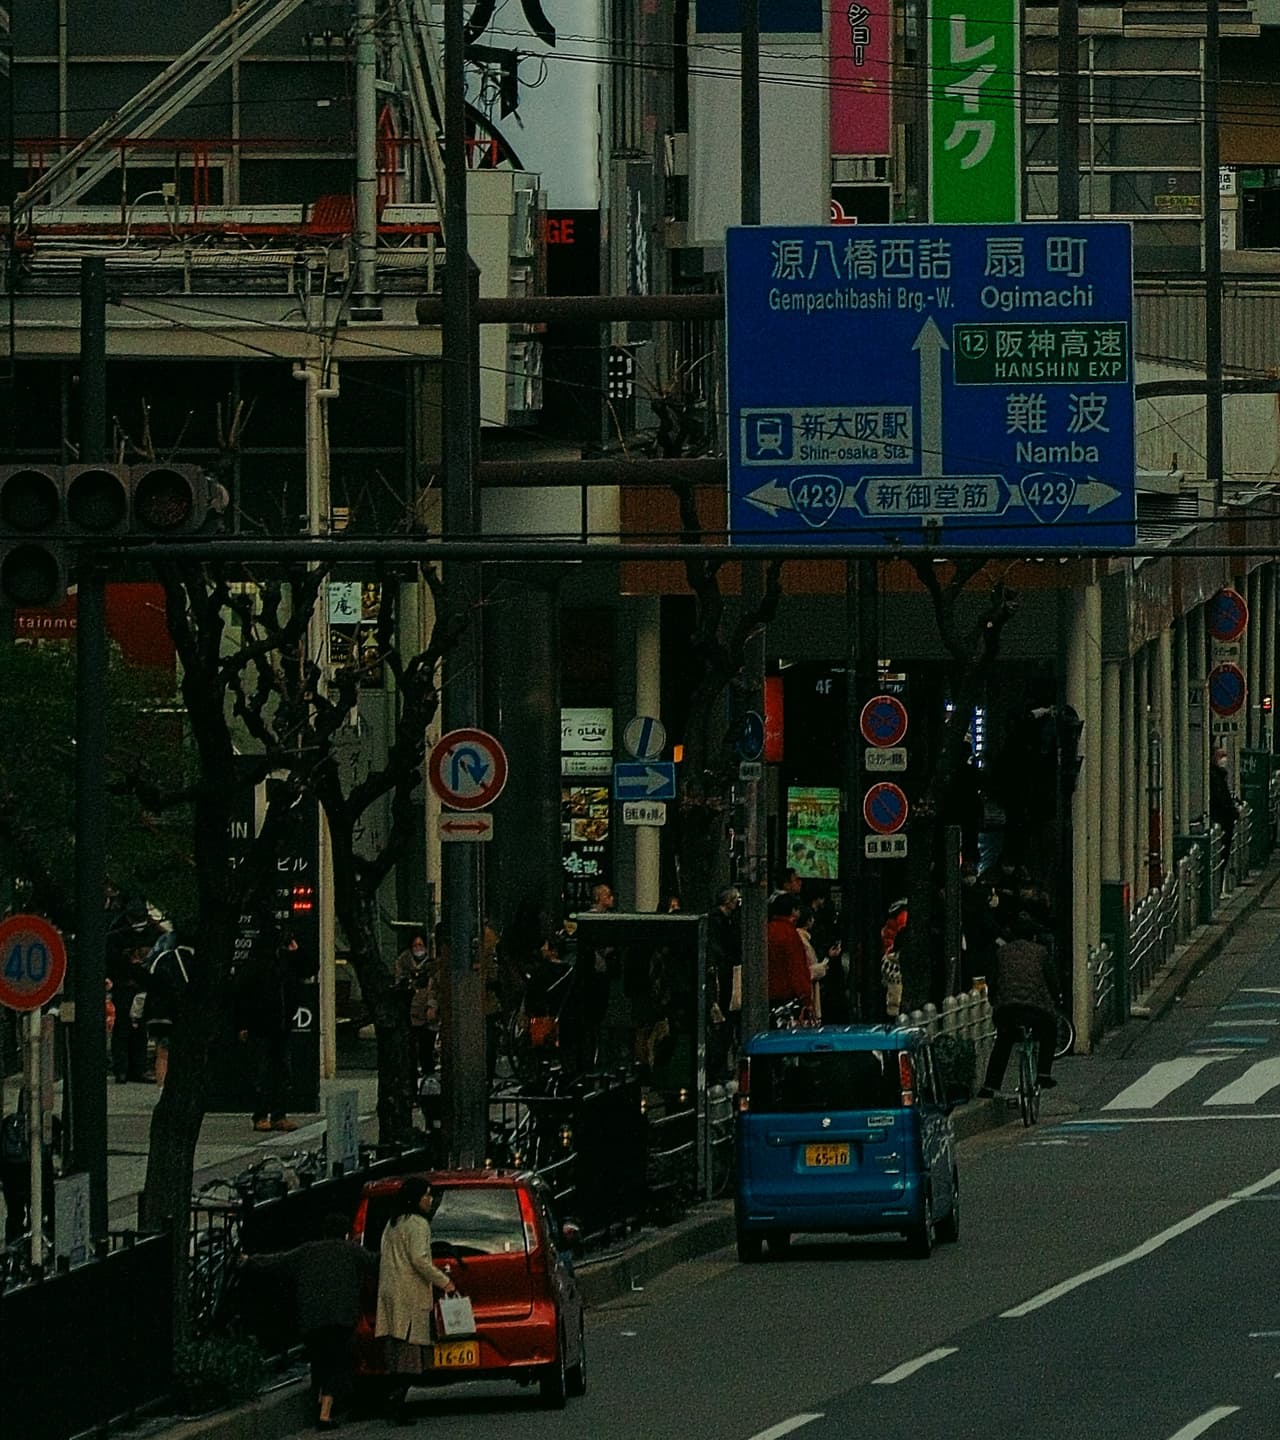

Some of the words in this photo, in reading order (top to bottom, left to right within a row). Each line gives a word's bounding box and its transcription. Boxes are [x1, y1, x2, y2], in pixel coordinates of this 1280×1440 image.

[944, 14, 997, 170] レイク
[770, 238, 951, 281] 源八橋西詰
[984, 236, 1088, 278] 扇町
[769, 288, 892, 315] Gempachibashi
[981, 284, 1093, 311] Ogimachi
[961, 333, 986, 353] 12
[995, 330, 1122, 358] 阪神高速
[995, 362, 1079, 377] HANSHIN
[1088, 361, 1122, 377] EXP
[799, 413, 907, 441] 新大阪駅
[1005, 392, 1110, 435] 難波
[799, 444, 878, 461] Shin-osaka
[883, 444, 909, 460] Sta.
[1015, 441, 1100, 464] Namba
[796, 482, 837, 508] 423
[876, 483, 988, 509] 新御堂筋
[1026, 480, 1068, 507] 423
[4, 943, 48, 982] 40
